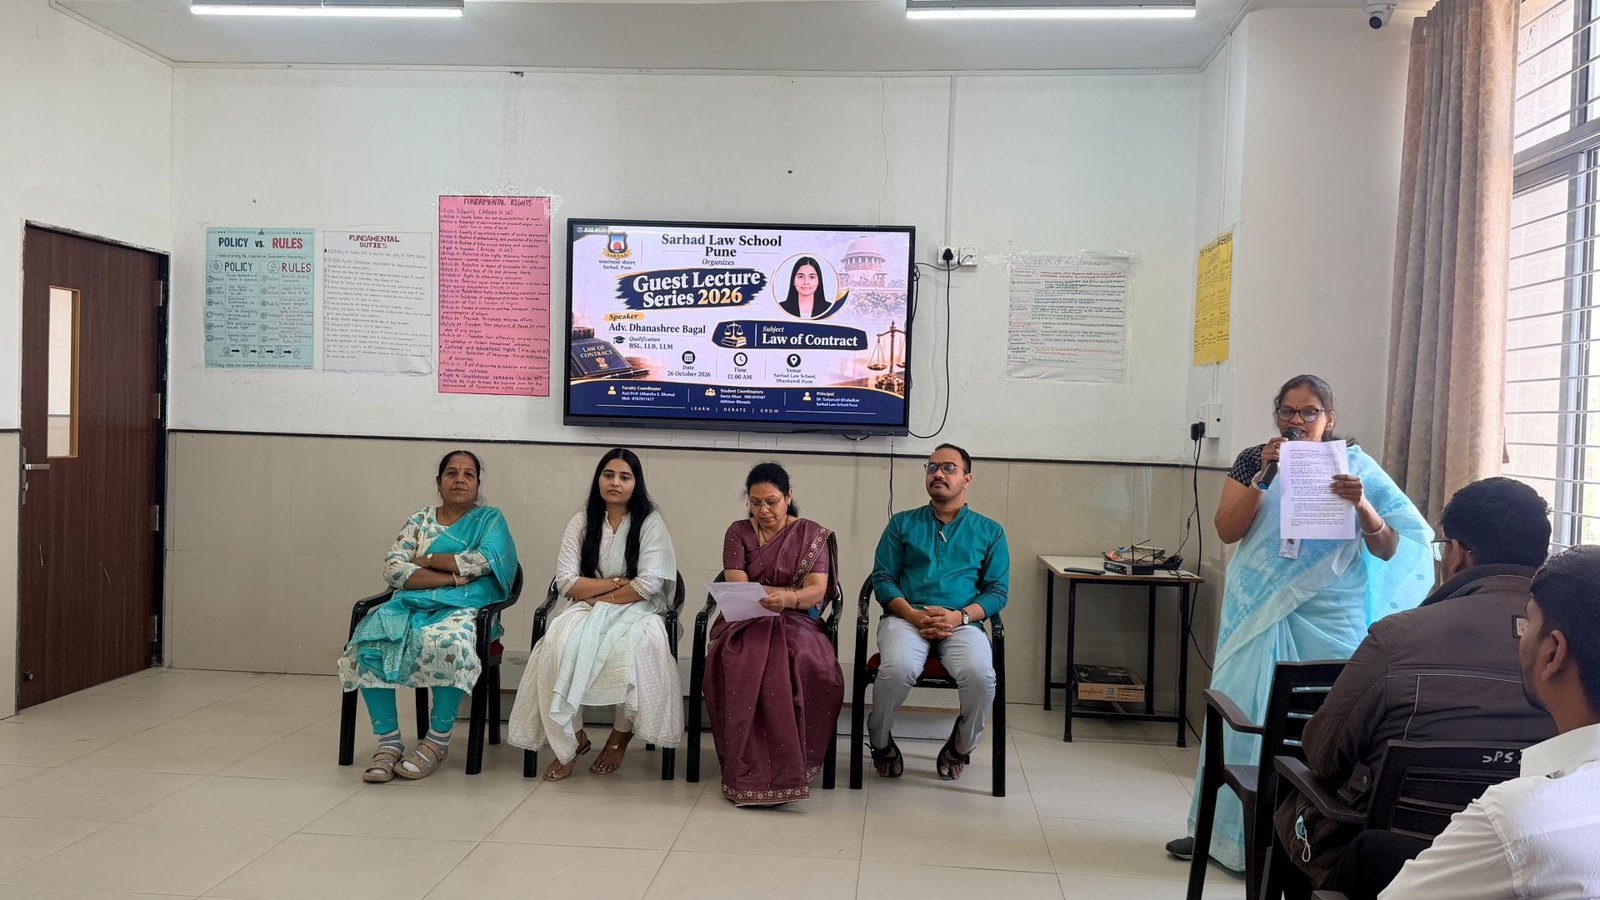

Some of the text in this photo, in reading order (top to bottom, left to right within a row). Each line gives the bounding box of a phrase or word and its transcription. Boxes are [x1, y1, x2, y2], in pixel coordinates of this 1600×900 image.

[219, 238, 248, 247] POLICY
[272, 238, 303, 249] RULES
[661, 234, 781, 246] Sarhad Law School
[705, 247, 736, 257] Pune
[224, 262, 253, 272] POLICY
[281, 263, 311, 273] RULES
[633, 271, 760, 292] Guest Lecture
[643, 287, 743, 308] Series 2026
[629, 324, 680, 333] Dhanashree
[682, 325, 706, 335] Bagal
[762, 333, 857, 346] Law of Contract
[580, 349, 613, 359] CONTRACT
